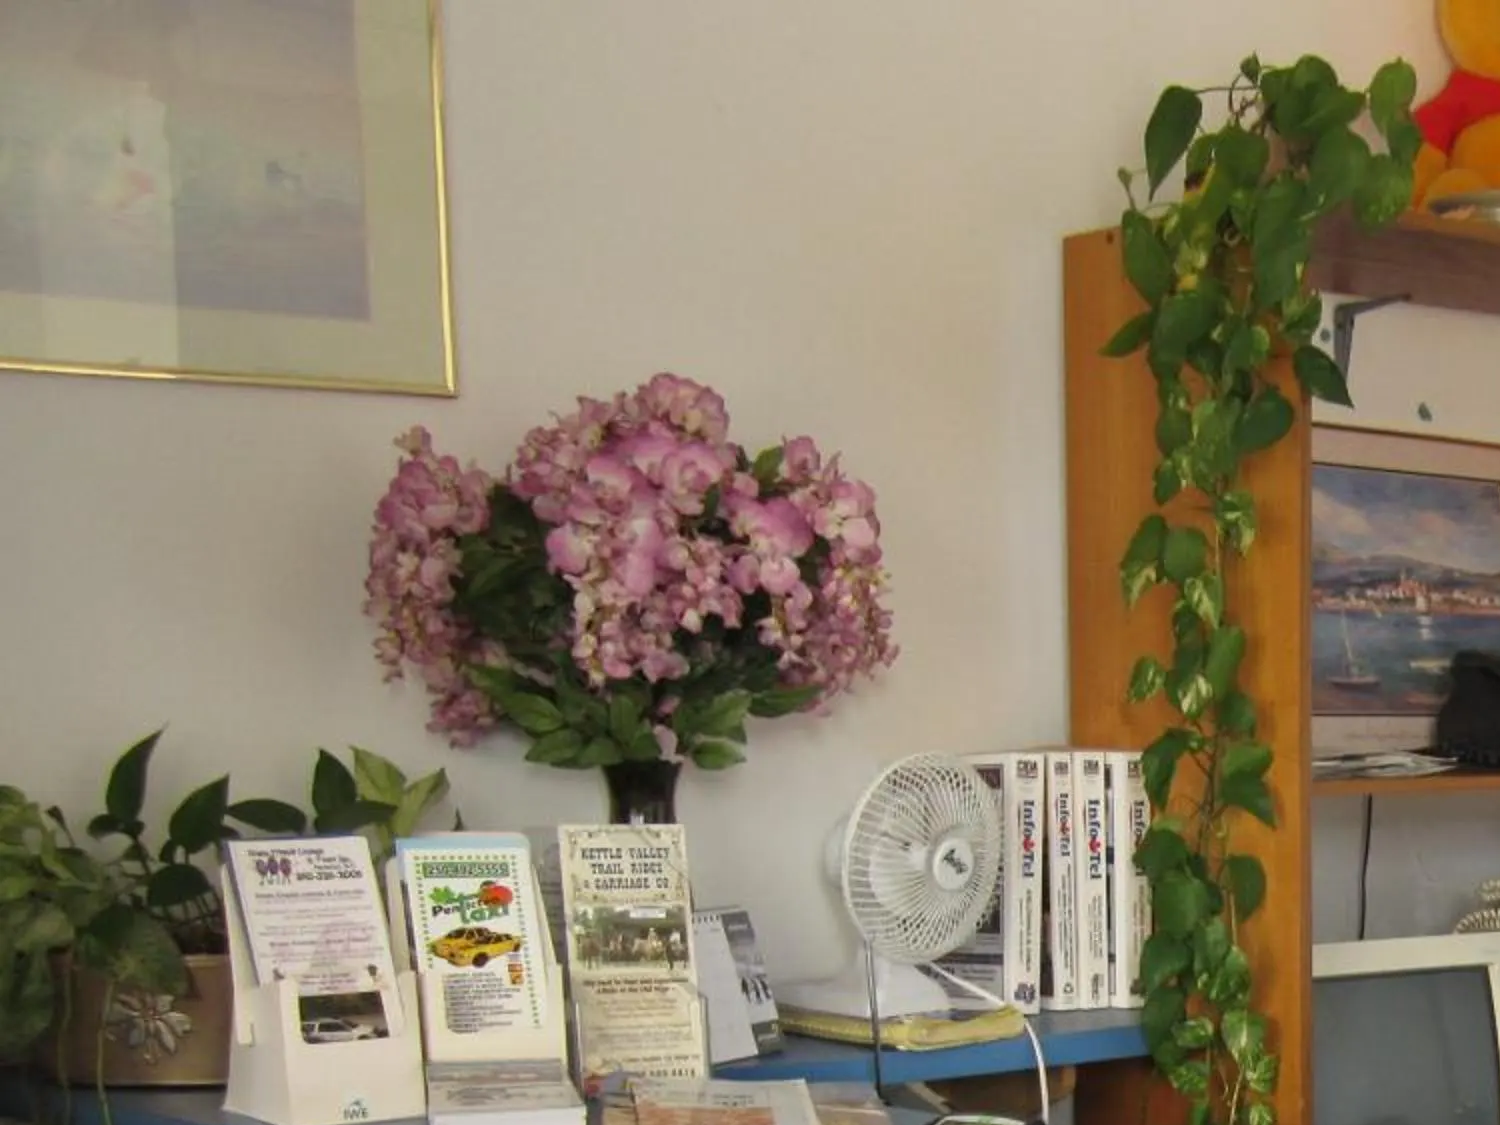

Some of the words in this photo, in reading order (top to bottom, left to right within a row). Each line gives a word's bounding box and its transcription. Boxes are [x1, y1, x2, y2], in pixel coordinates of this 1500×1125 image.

[581, 847, 623, 860] KETTLE
[628, 847, 671, 860] VALLEY
[591, 863, 624, 875] TRAIL
[594, 877, 651, 890] CARRIAGE
